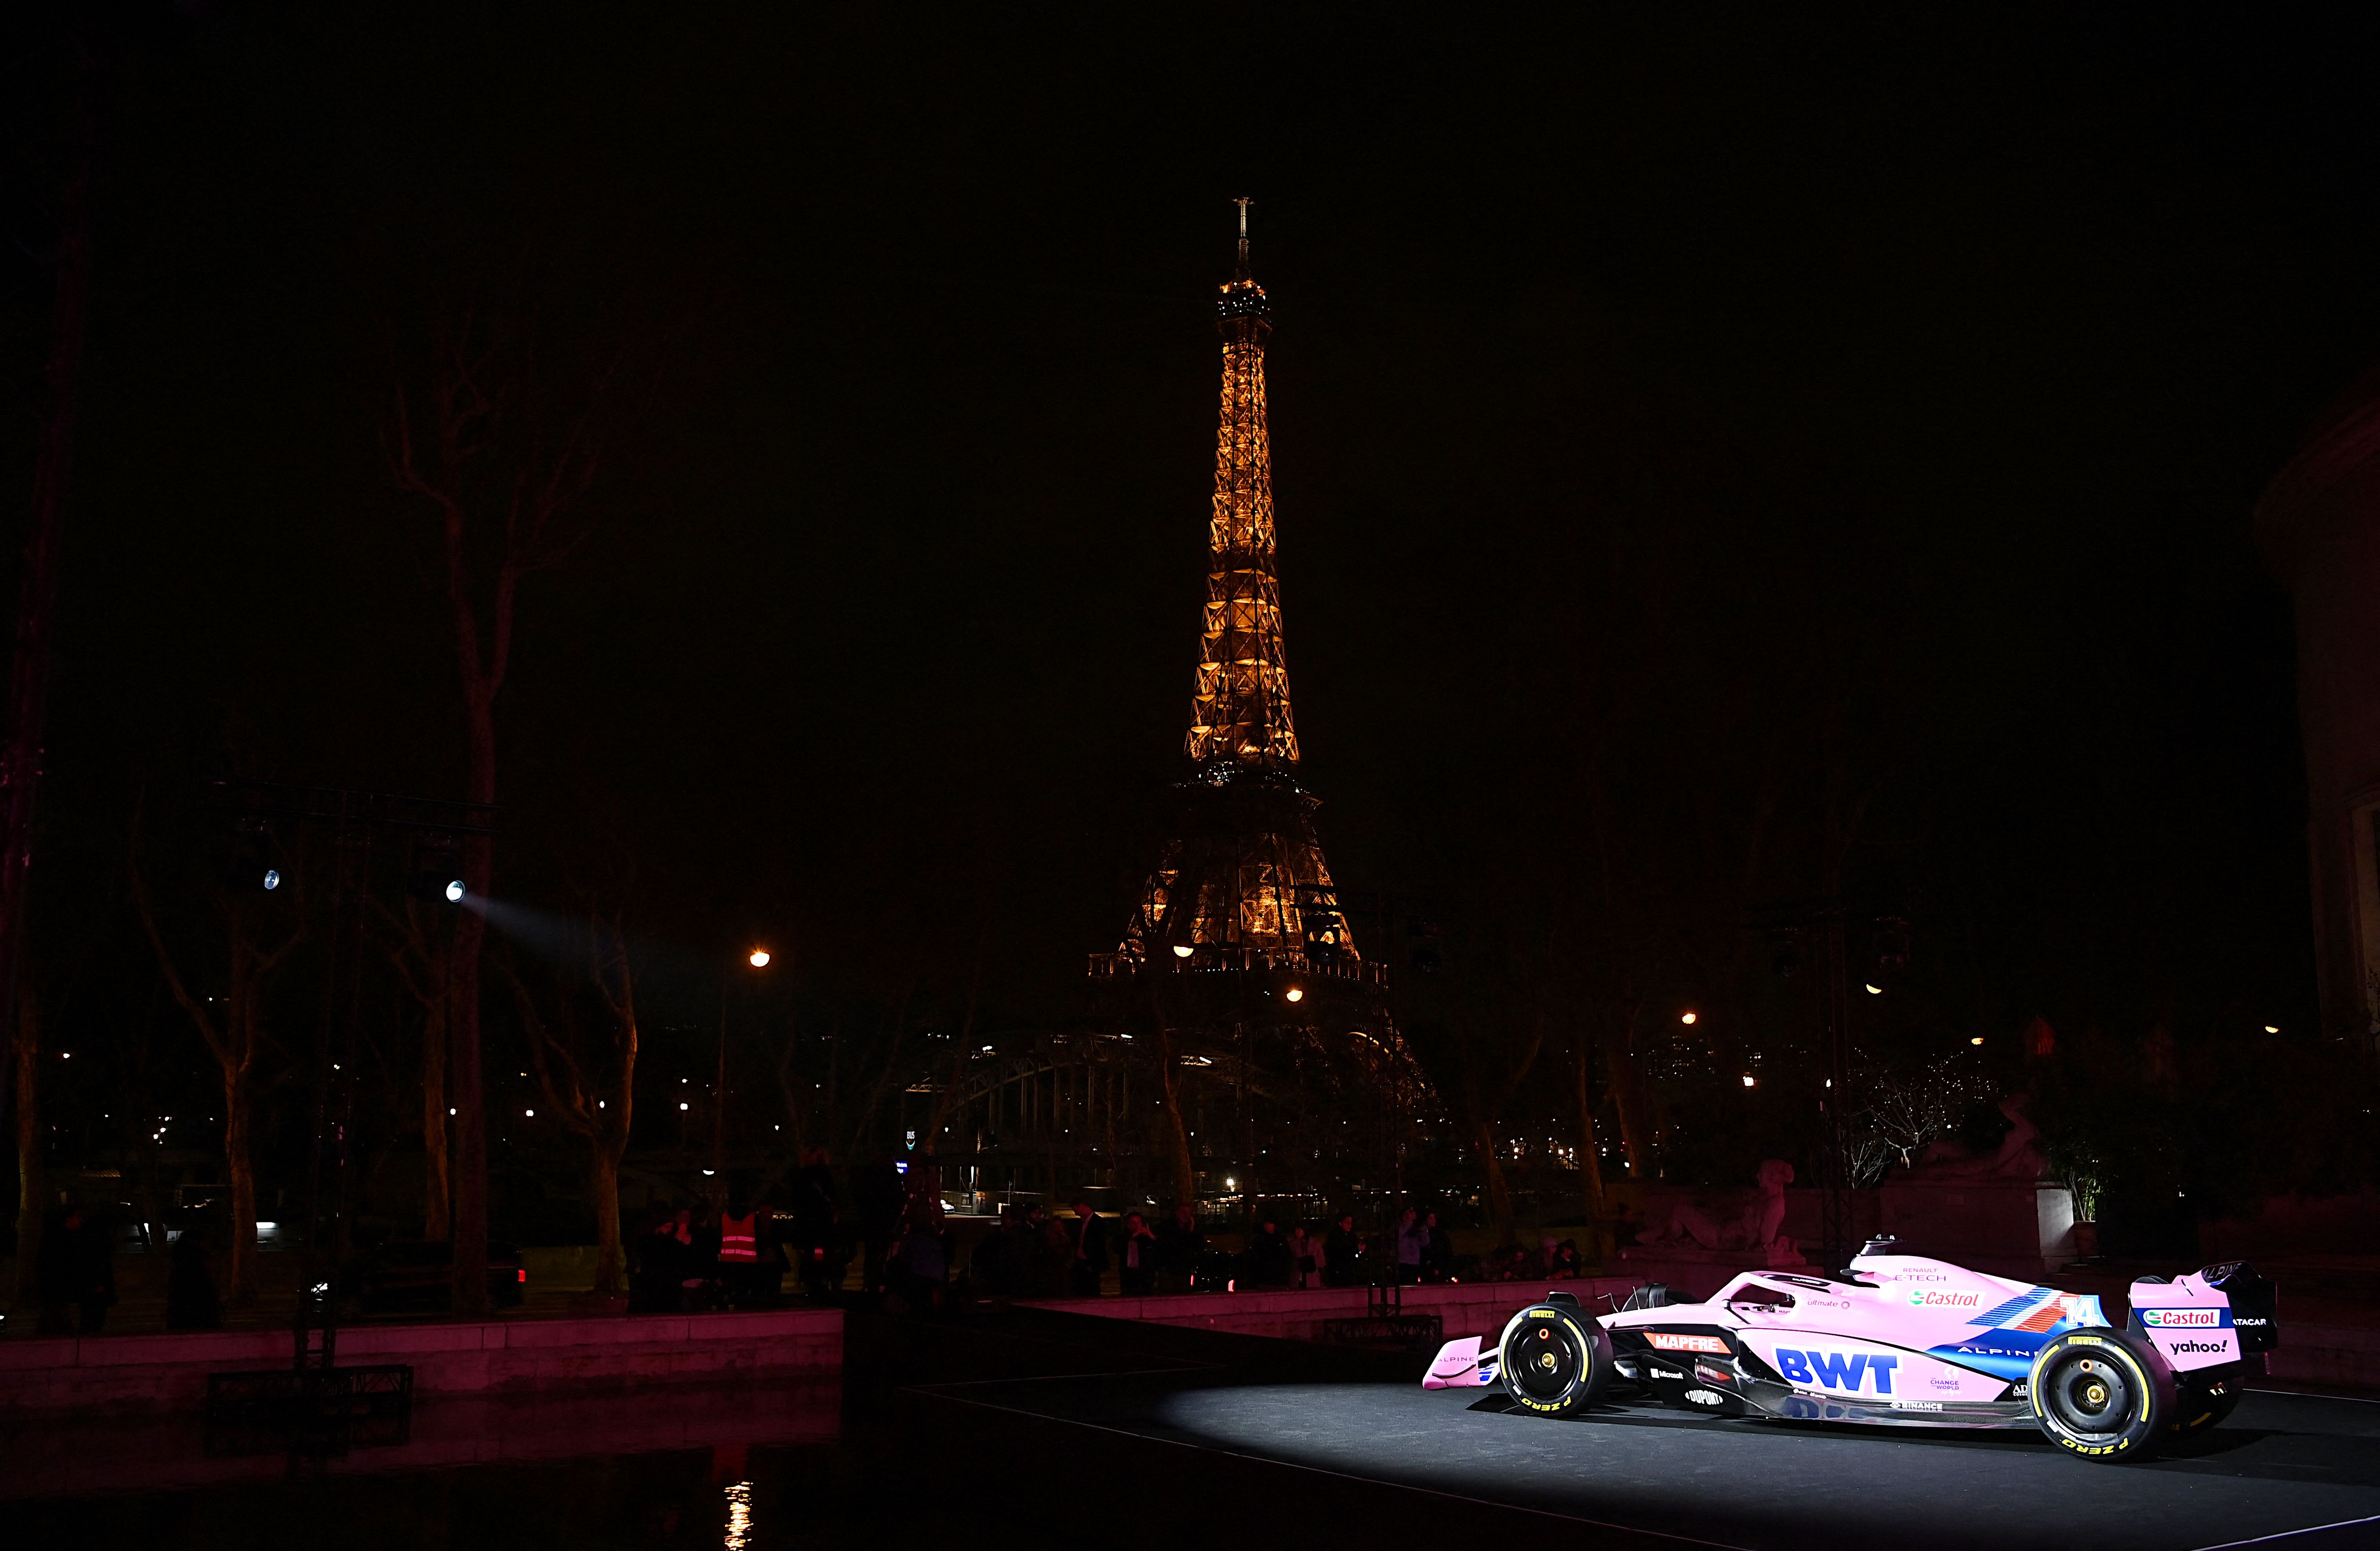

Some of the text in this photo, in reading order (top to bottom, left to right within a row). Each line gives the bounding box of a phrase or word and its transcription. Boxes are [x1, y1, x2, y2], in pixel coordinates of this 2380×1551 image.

[907, 1131, 915, 1139] BUS
[1807, 1299, 1838, 1307] ultimate
[1926, 1292, 1979, 1306] Castrol
[1529, 1310, 1555, 1318] PIRELLI
[2060, 1297, 2100, 1327] 14
[2163, 1312, 2216, 1324] Castrol
[1655, 1335, 1718, 1351] MAPFRE
[2067, 1336, 2103, 1345] PIRELLI
[2169, 1340, 2228, 1355] yahoo!
[1659, 1370, 1684, 1379] Microsoft
[1775, 1348, 1897, 1394] BWT
[1521, 1396, 1571, 1411] P ZERO
[1689, 1390, 1720, 1405] DUPONT
[1901, 1402, 1942, 1410] BINANCE
[2061, 1437, 2129, 1455] P ZERO
